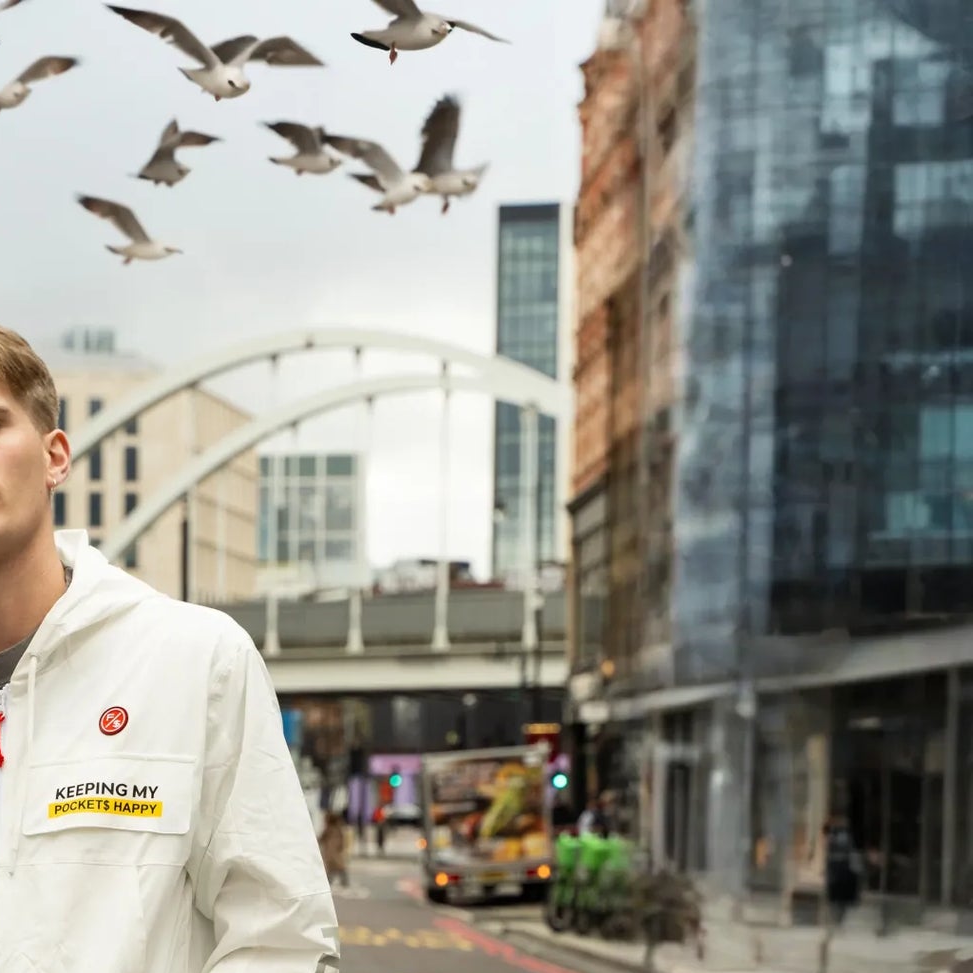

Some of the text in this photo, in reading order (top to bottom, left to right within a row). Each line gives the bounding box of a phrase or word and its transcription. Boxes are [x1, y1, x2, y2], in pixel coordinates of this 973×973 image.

[55, 781, 159, 800] KEEPING MY
[54, 799, 158, 815] POCKET$ HAPPY
